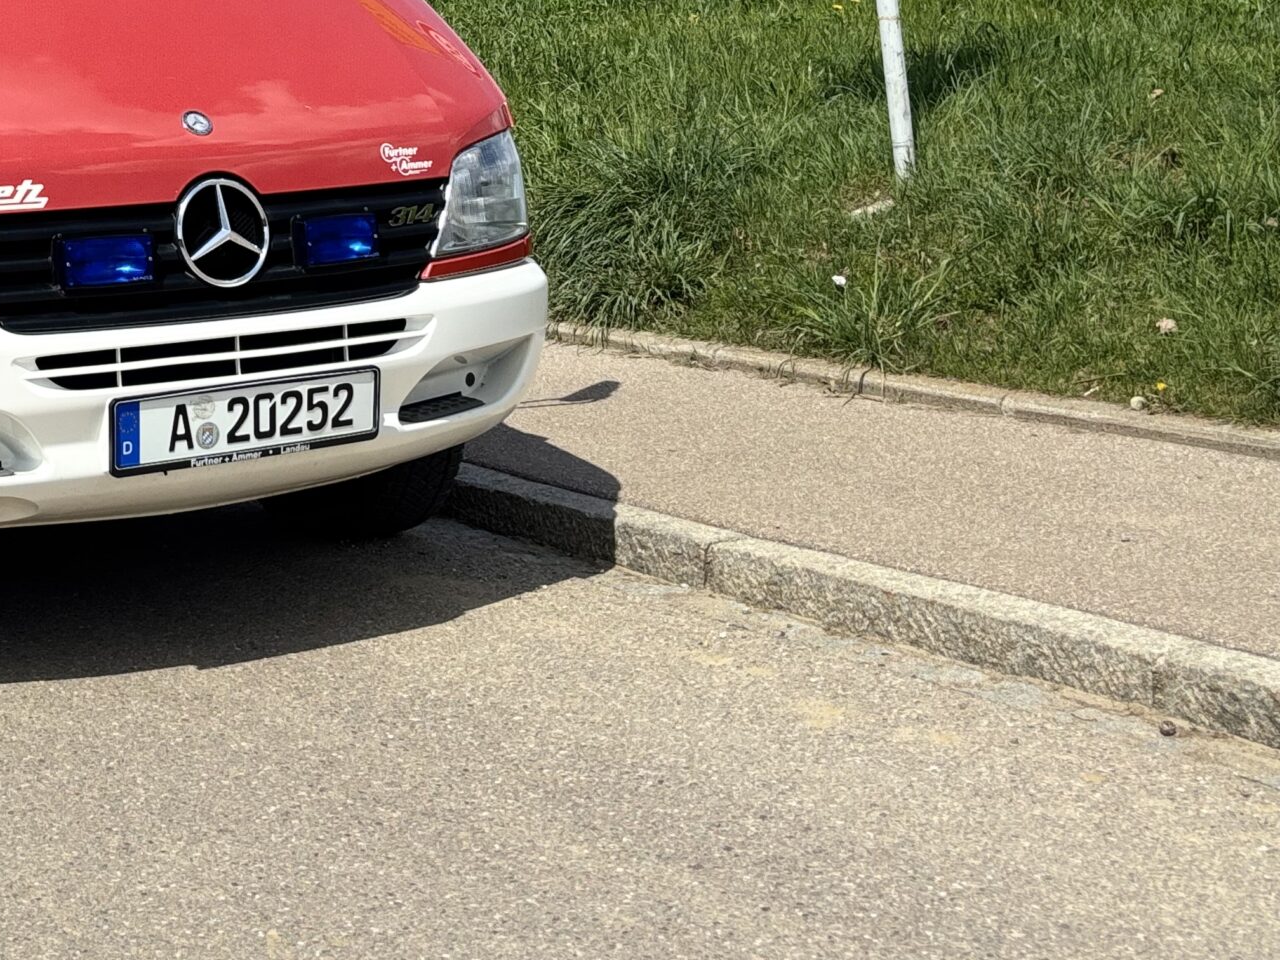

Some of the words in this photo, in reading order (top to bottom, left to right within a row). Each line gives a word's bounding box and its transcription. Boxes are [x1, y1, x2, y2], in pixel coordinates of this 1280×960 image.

[400, 160, 433, 171] Ammer
[388, 203, 434, 227] 314
[169, 404, 194, 452] A
[227, 382, 353, 445] 20252
[122, 440, 133, 455] D
[190, 456, 223, 469] Furtner
[231, 451, 262, 462] Ammer
[280, 443, 310, 455] Landau
